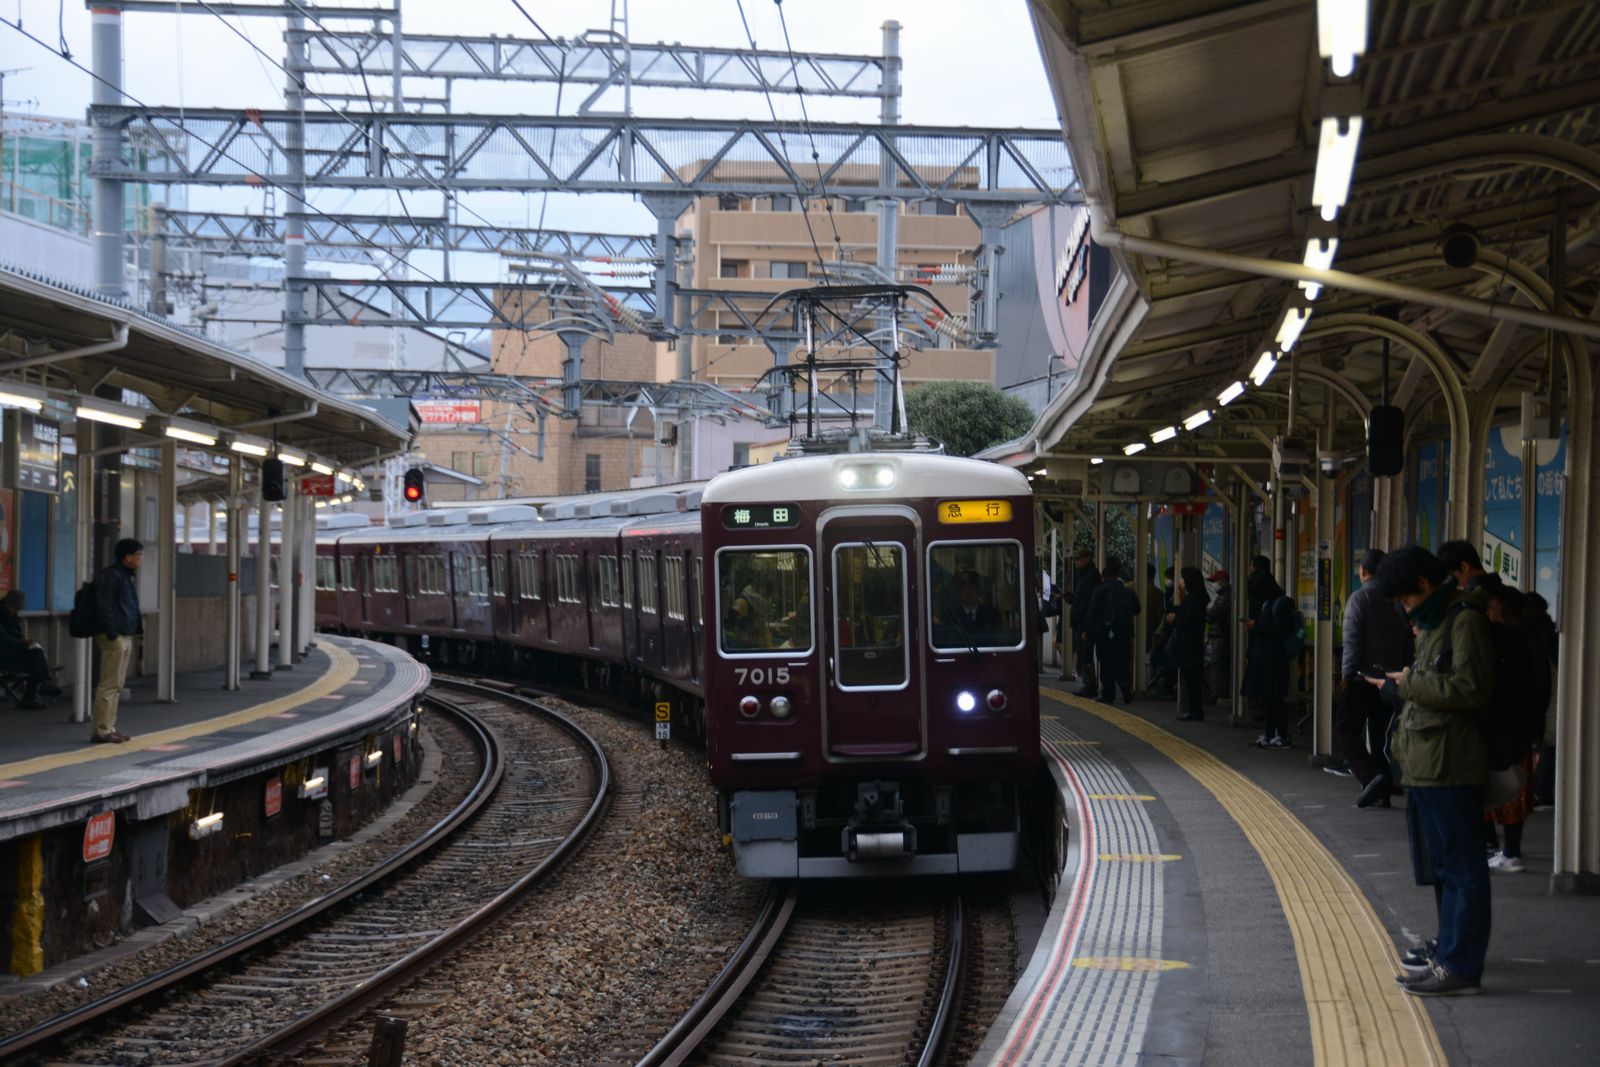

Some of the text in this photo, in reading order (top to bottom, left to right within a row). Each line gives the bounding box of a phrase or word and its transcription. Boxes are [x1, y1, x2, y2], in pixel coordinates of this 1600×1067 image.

[734, 508, 788, 524] 梅田
[946, 503, 1000, 517] 急行
[1482, 542, 1518, 581] コ乗り
[735, 667, 790, 686] 7015
[657, 704, 669, 719] S
[320, 805, 331, 830] 201
